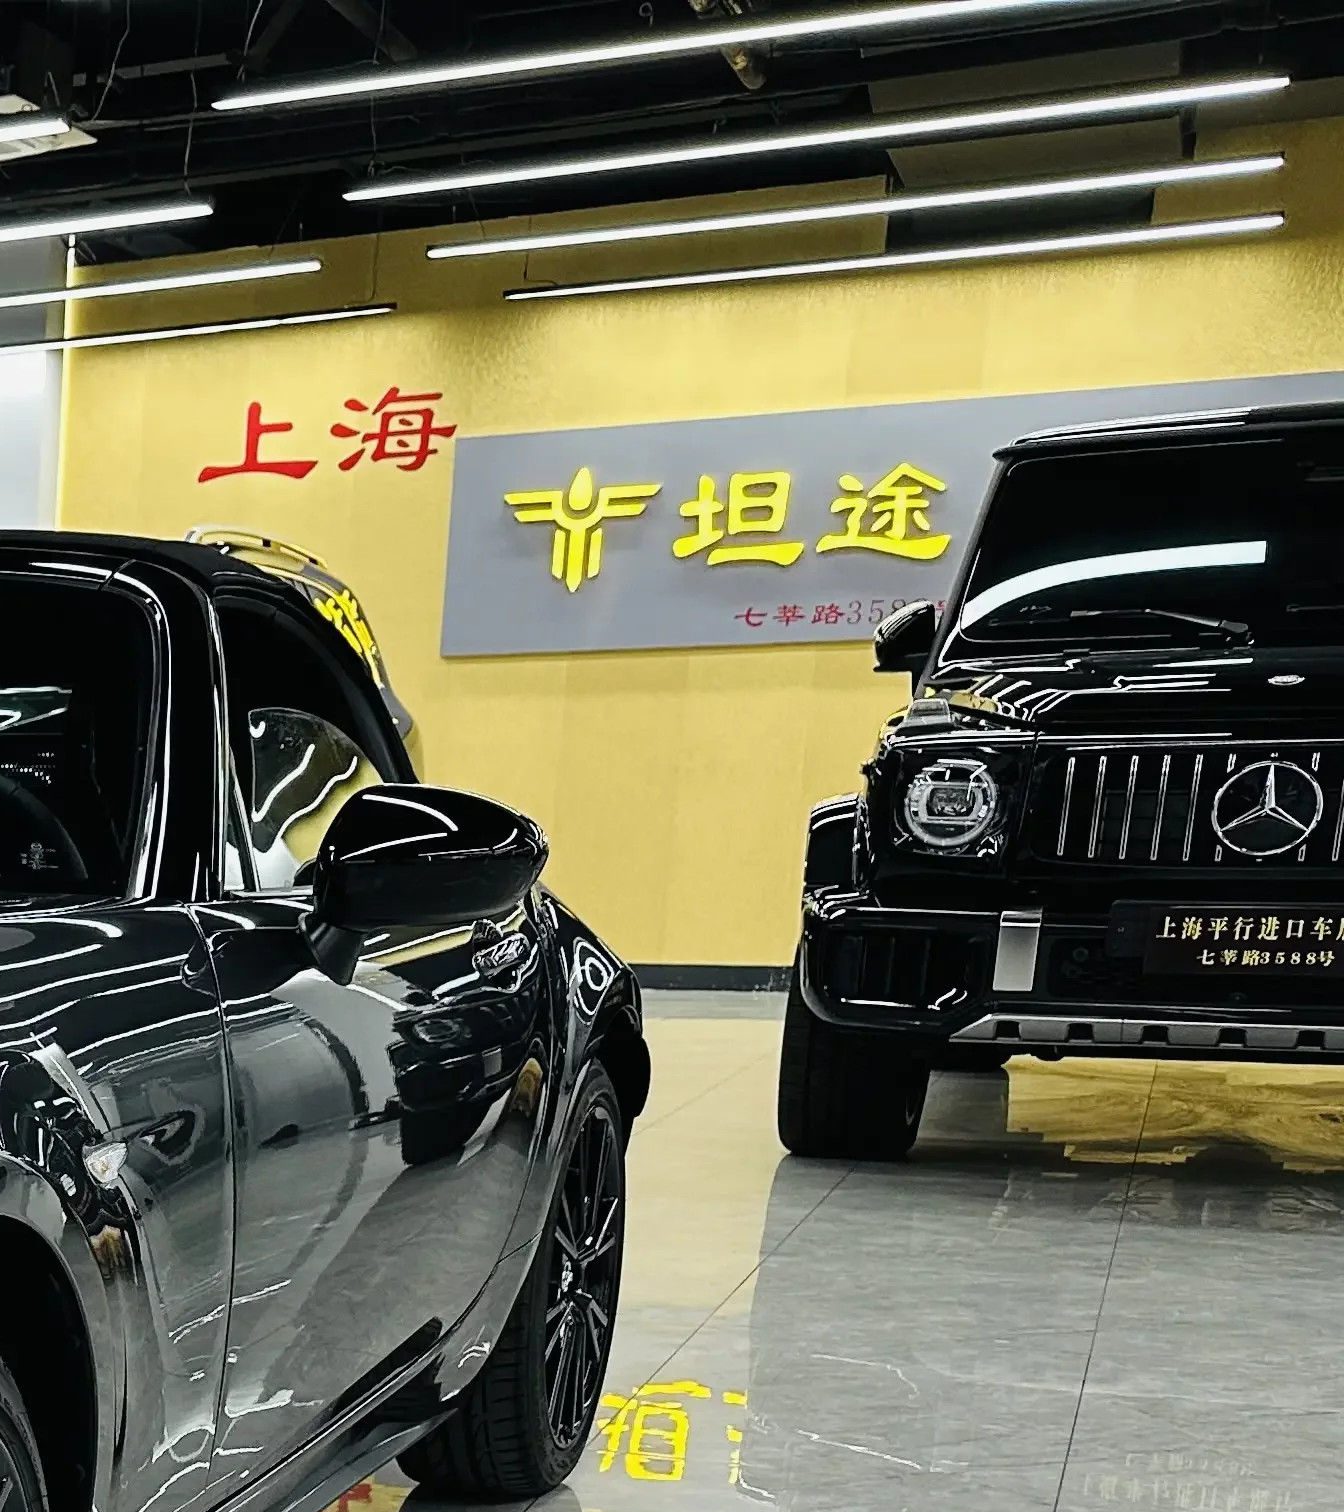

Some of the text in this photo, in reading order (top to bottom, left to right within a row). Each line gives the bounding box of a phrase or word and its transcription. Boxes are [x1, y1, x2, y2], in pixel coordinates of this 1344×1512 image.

[197, 386, 458, 483] 上海
[671, 461, 952, 567] 坦途
[734, 598, 946, 627] 七莘路35
